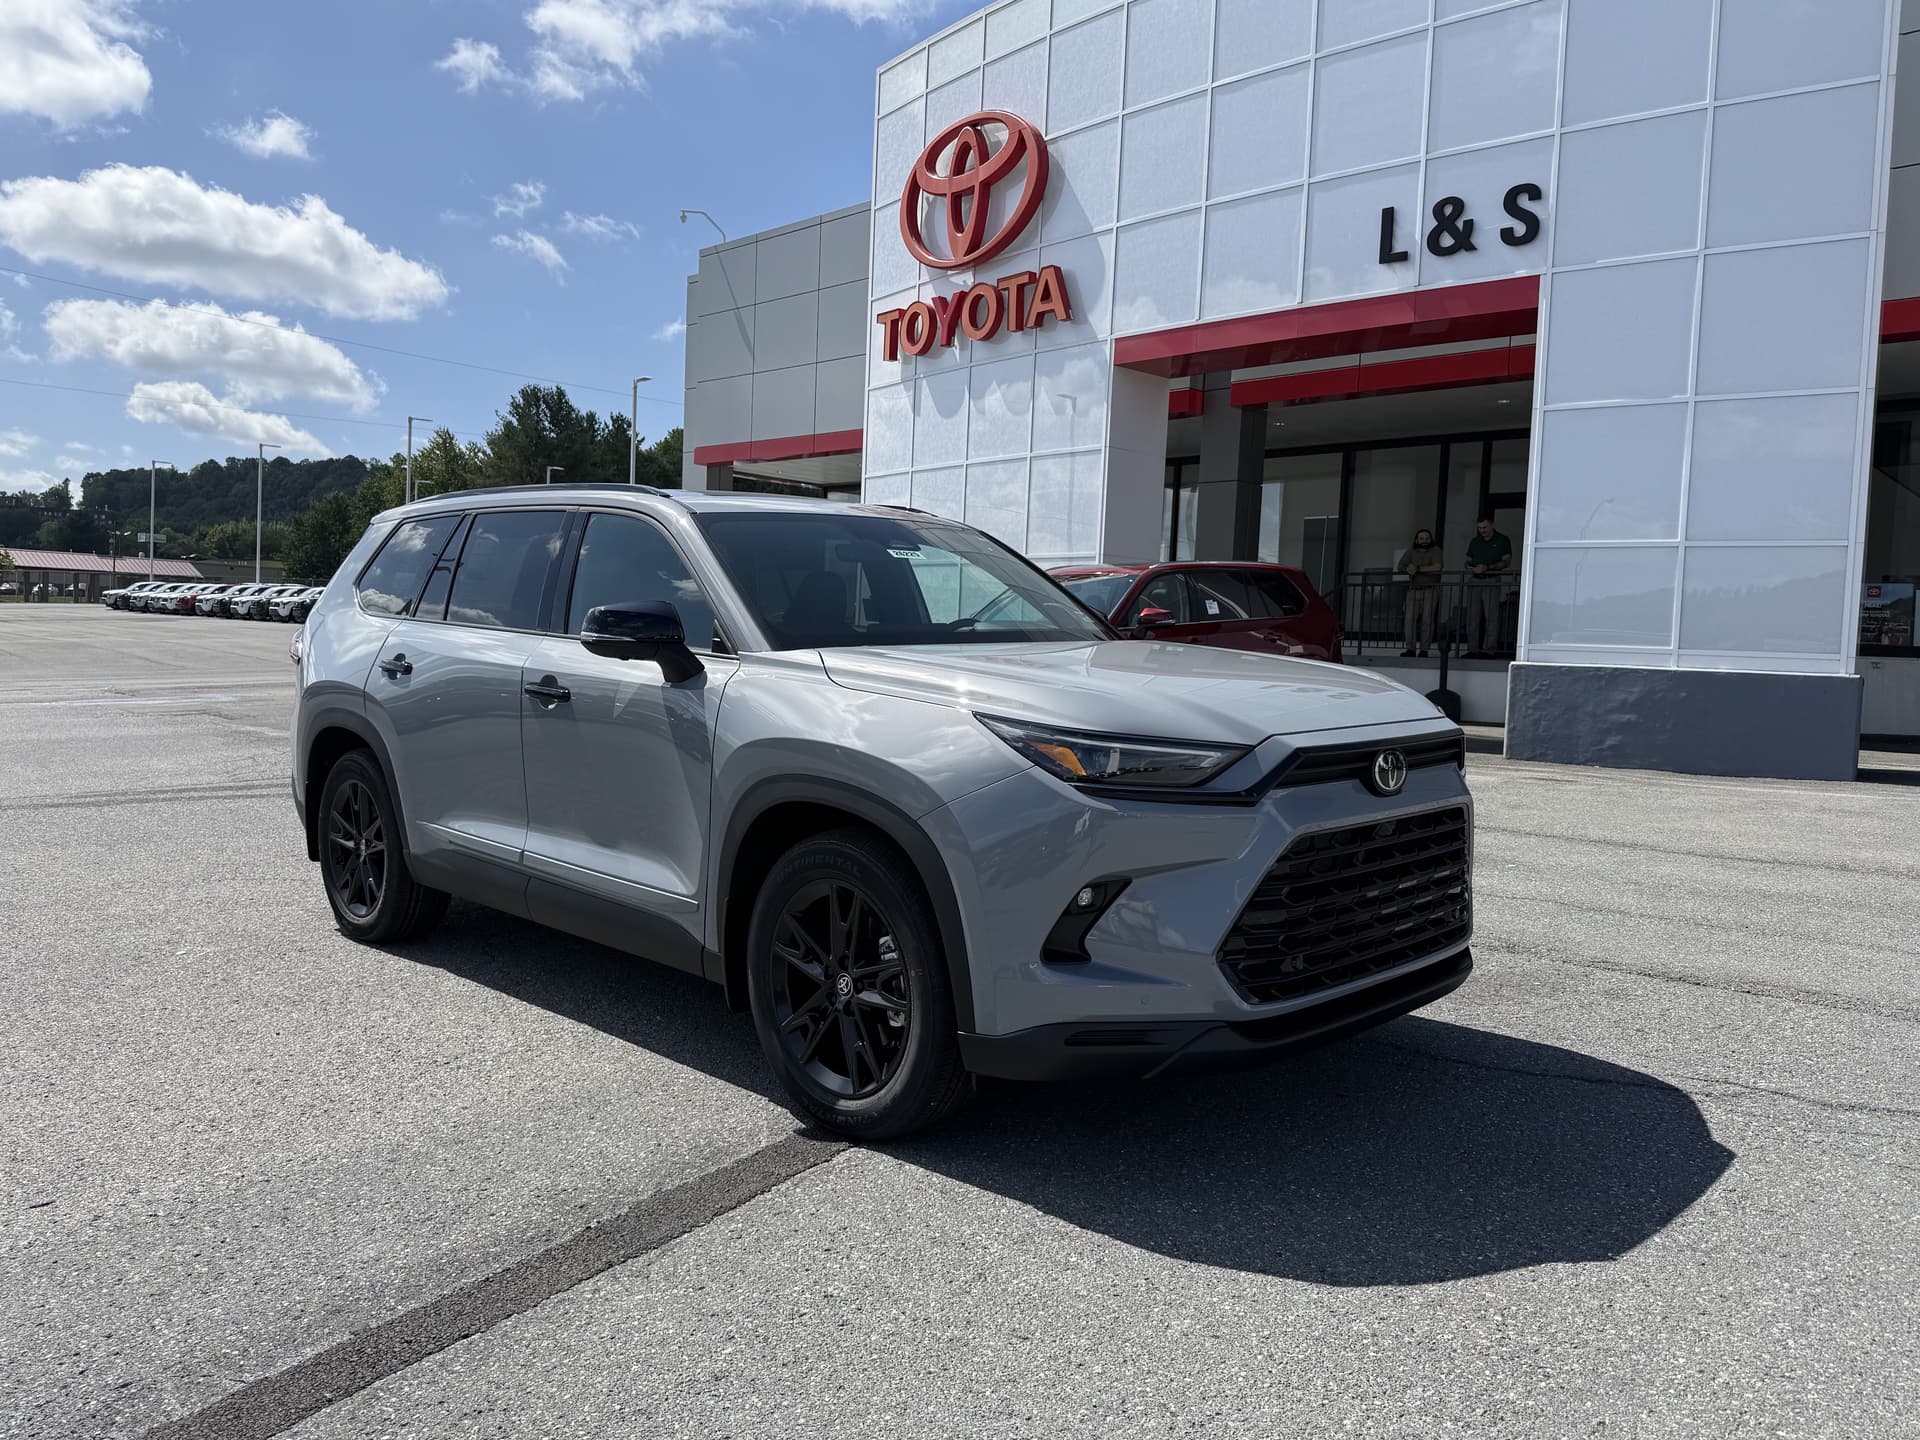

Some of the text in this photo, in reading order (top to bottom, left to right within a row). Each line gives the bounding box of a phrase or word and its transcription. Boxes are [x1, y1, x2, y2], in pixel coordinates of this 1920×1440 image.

[1379, 183, 1542, 264] L & S
[877, 264, 1072, 361] TOYOTA
